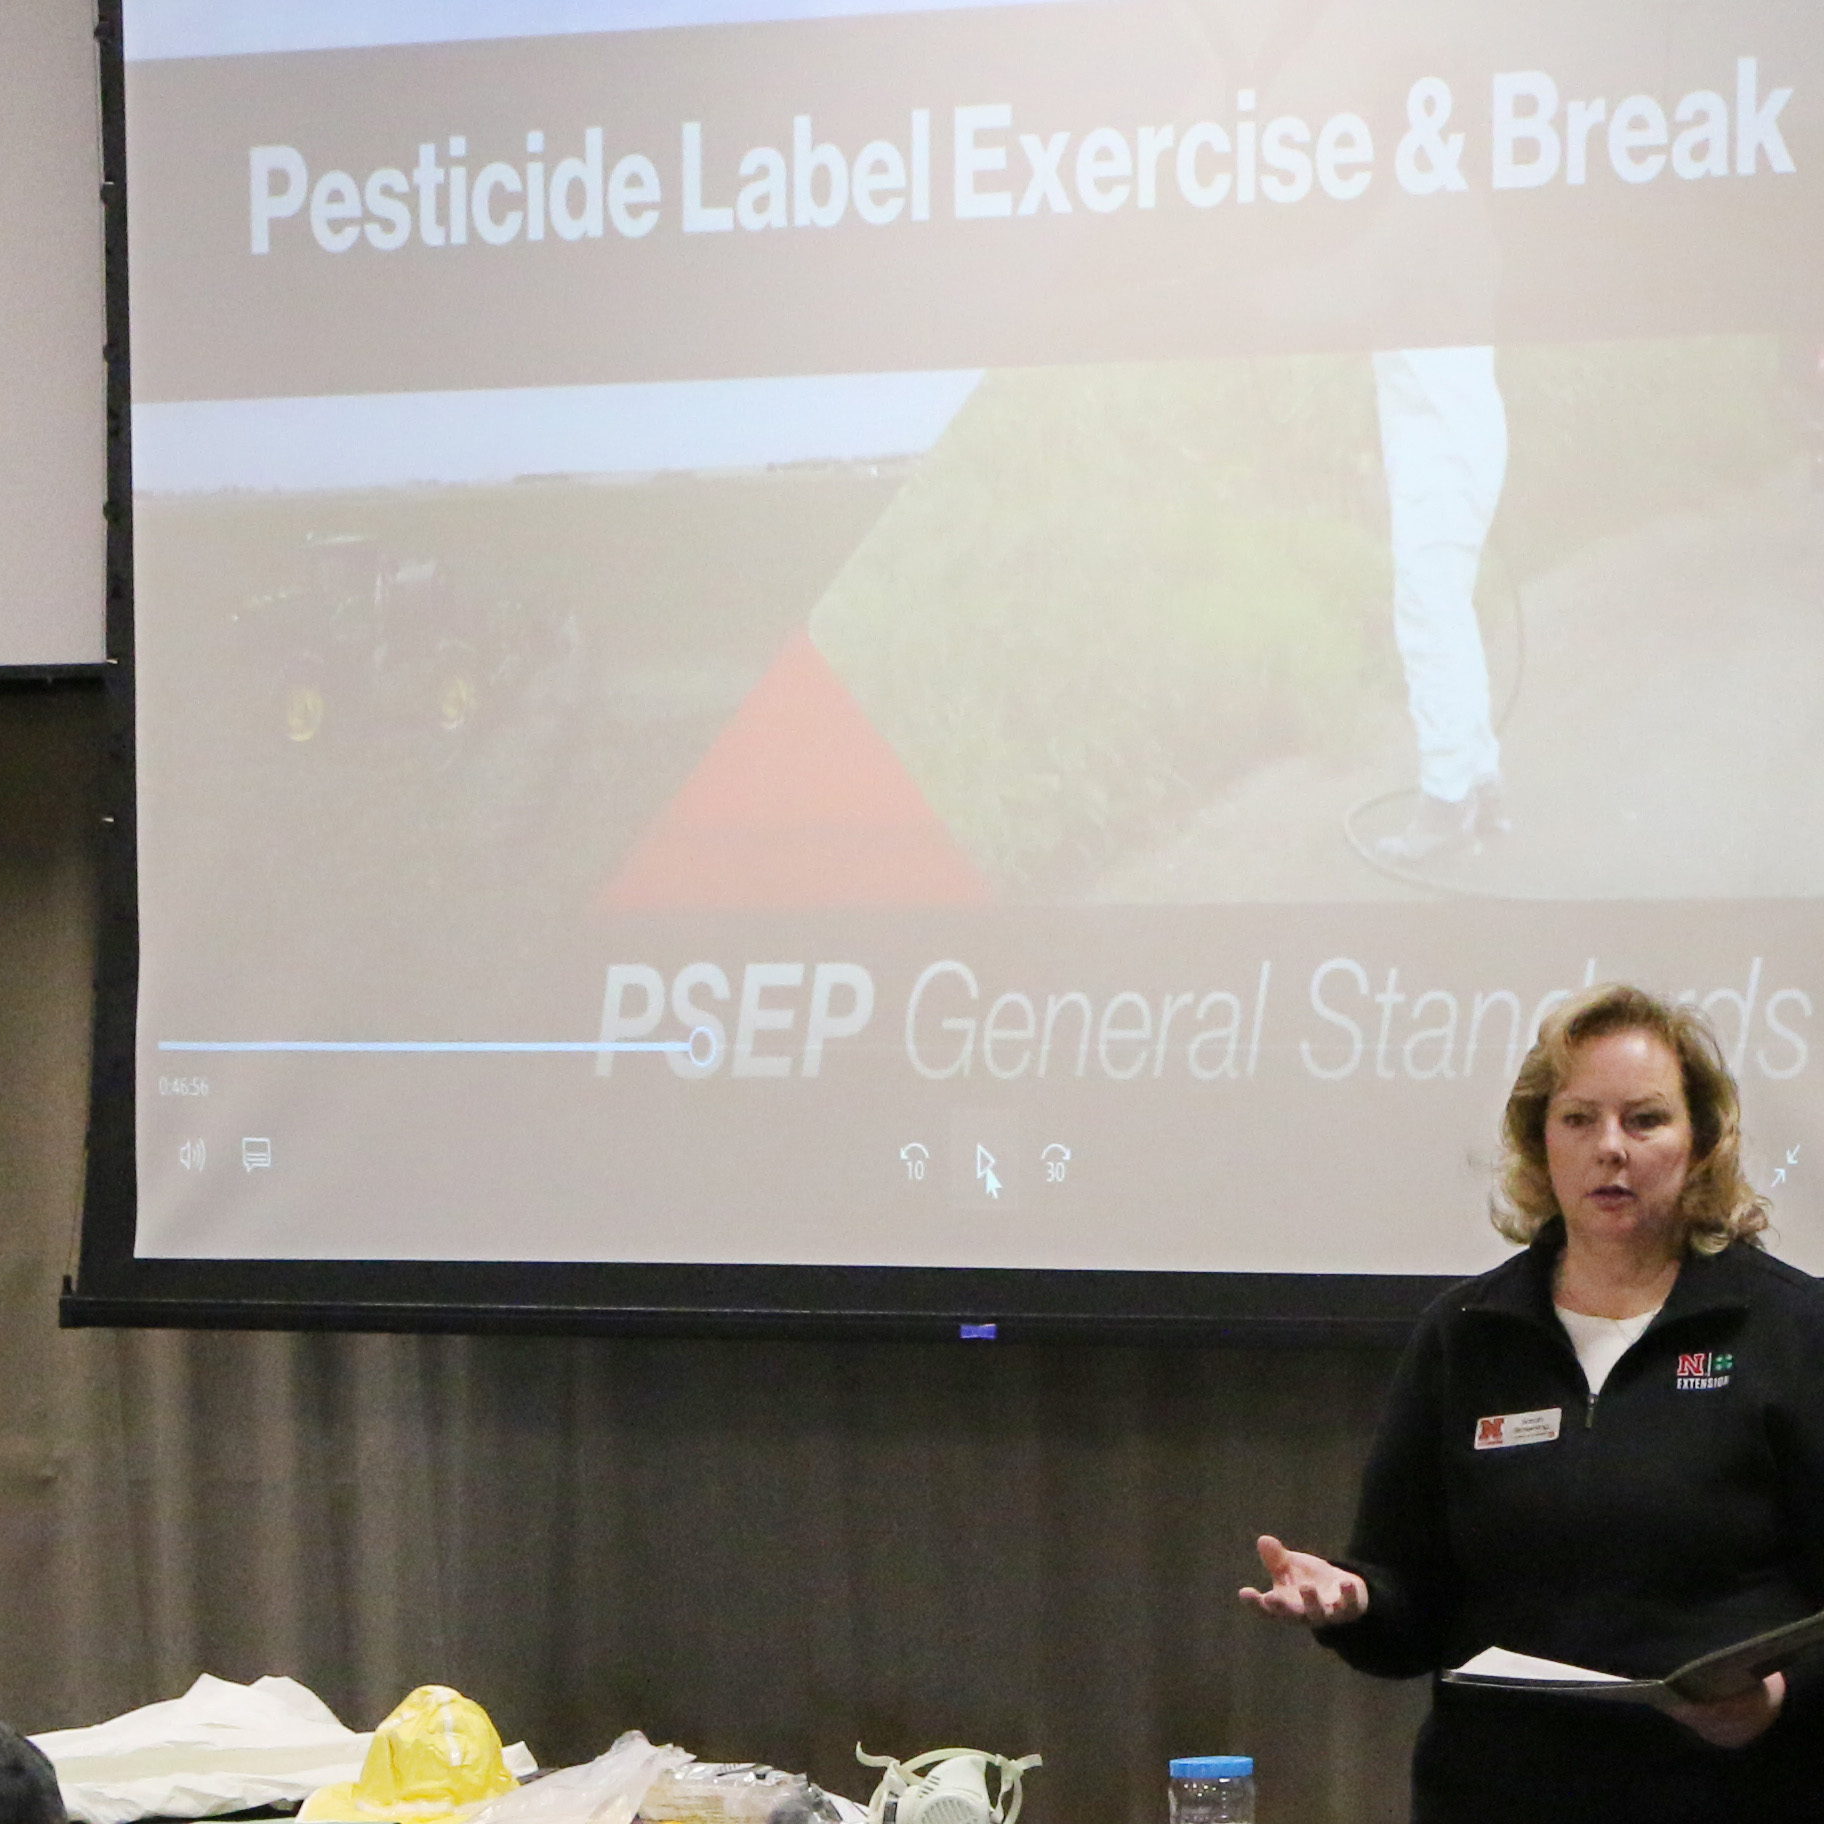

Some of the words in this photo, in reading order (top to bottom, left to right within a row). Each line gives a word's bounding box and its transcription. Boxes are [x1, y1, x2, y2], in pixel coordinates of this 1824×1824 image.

[248, 124, 661, 256] Pesticide
[680, 108, 931, 236] Label
[950, 86, 1375, 220] Exercise
[1392, 76, 1468, 195] &
[1490, 56, 1798, 191] Break
[594, 961, 874, 1079] PSEP
[906, 959, 1271, 1081] General
[1300, 956, 1814, 1081] Stands
[158, 1076, 210, 1096] 0:46:56
[905, 1160, 925, 1180] 10
[1046, 1161, 1066, 1183] 30
[1677, 1353, 1706, 1377] N
[1677, 1375, 1731, 1389] EXTENSION
